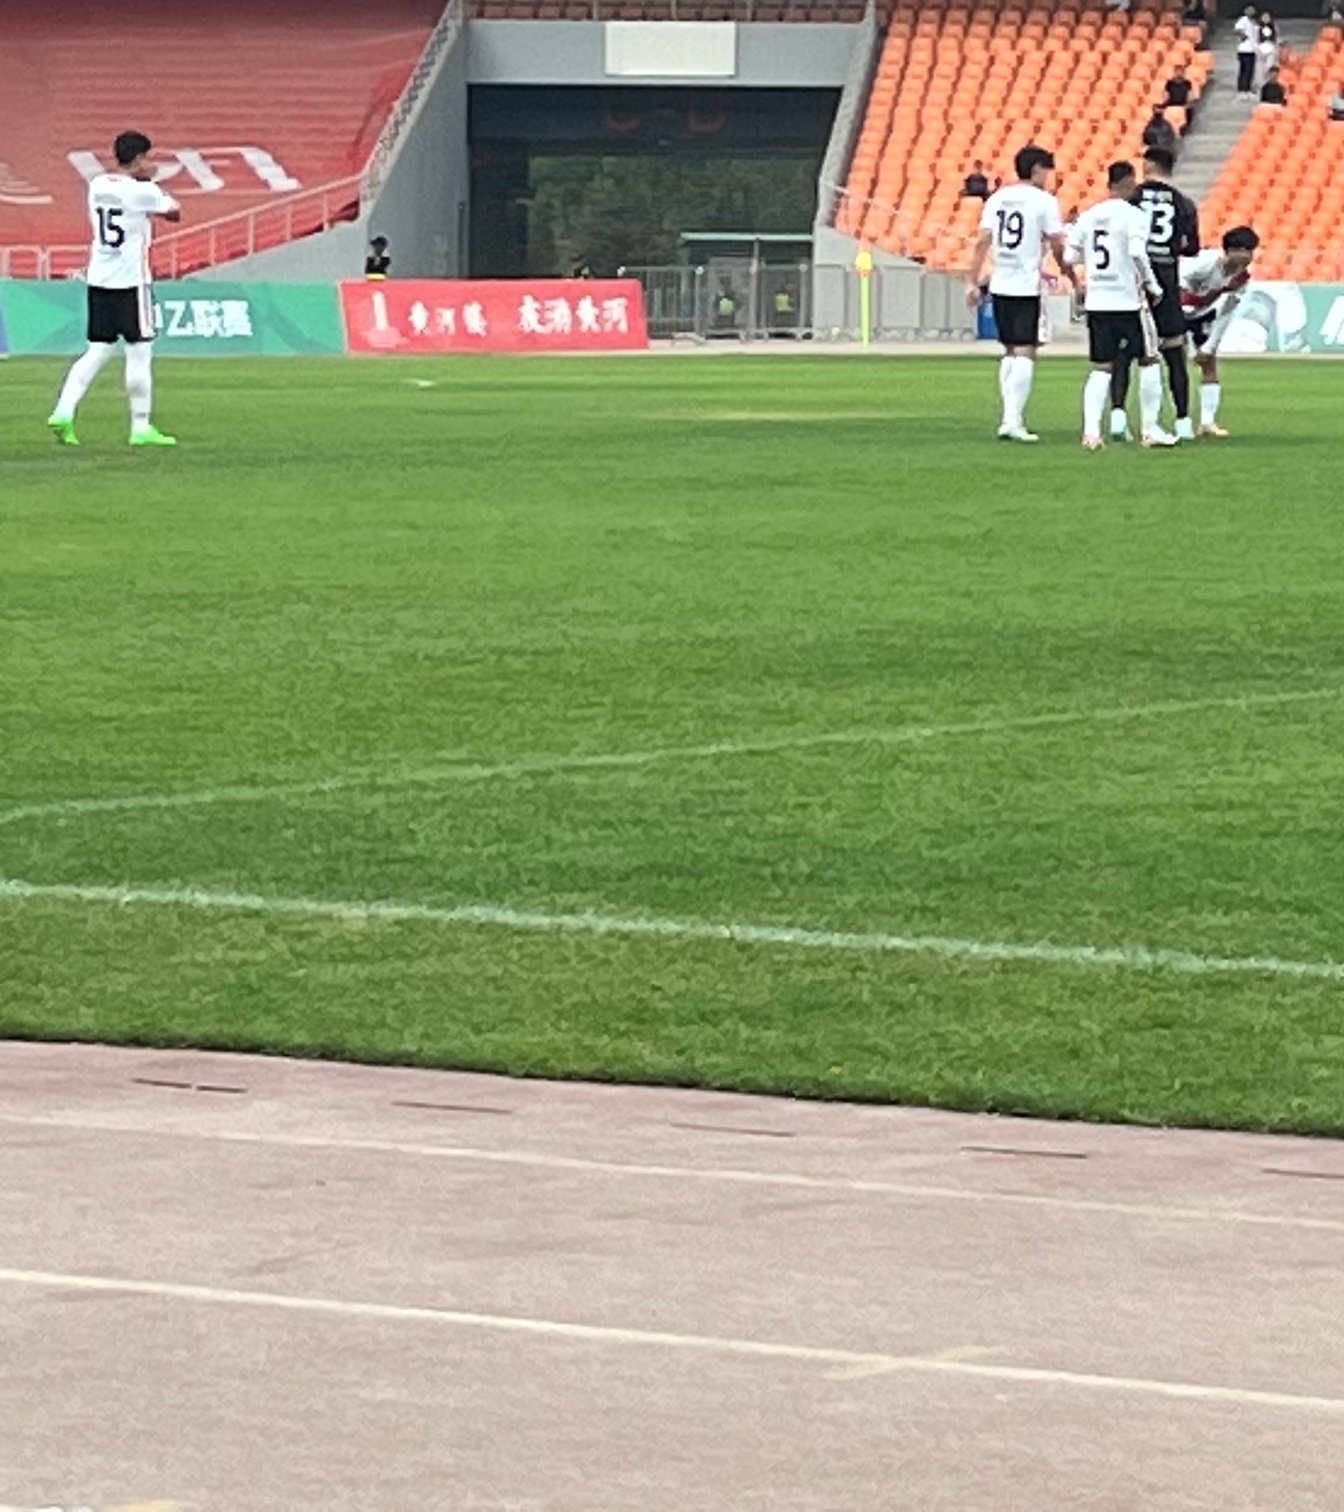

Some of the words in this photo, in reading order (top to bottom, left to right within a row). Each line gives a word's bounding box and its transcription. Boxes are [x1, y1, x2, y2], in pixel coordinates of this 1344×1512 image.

[95, 207, 124, 248] 15
[996, 210, 1024, 249] 19
[1093, 230, 1110, 269] 5
